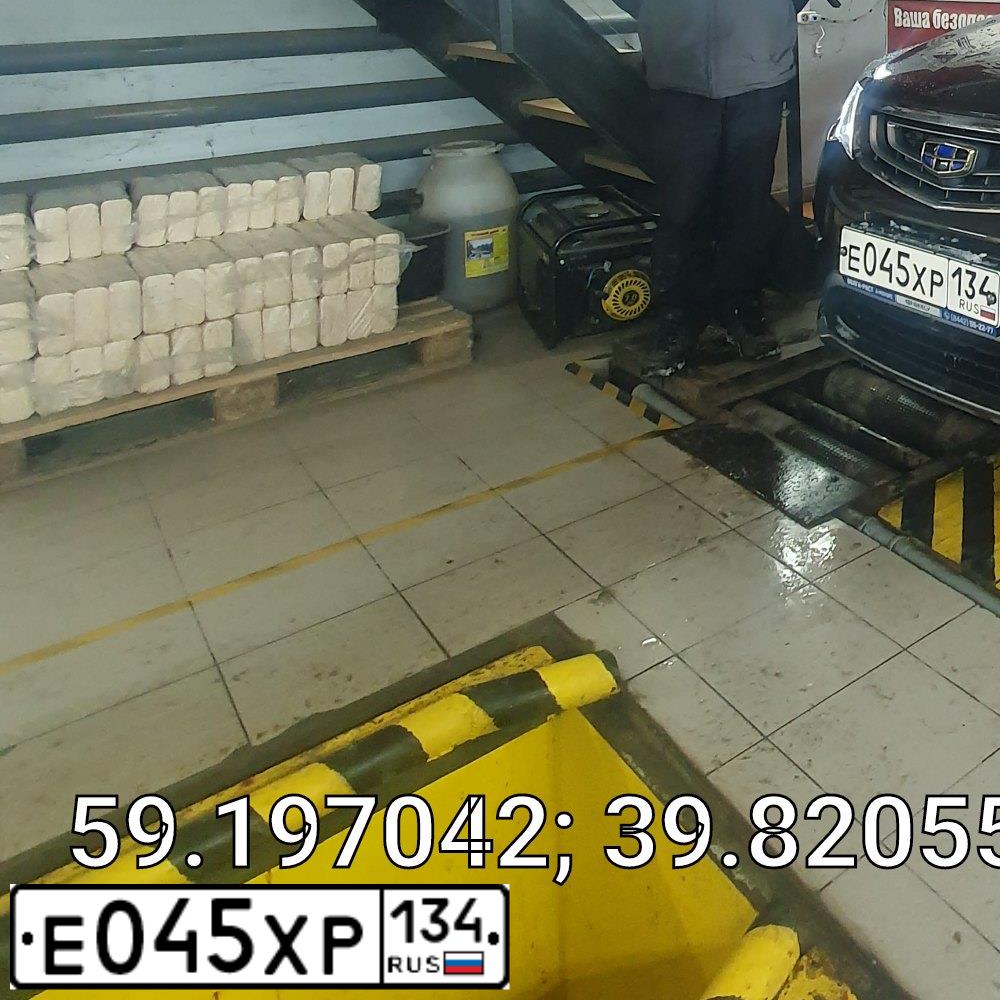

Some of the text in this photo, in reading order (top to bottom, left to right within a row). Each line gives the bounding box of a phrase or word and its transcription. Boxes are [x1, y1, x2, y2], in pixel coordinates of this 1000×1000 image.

[893, 7, 993, 30] Ваша безоп
[848, 242, 996, 306] Е045ХР 134
[959, 298, 980, 315] RUS
